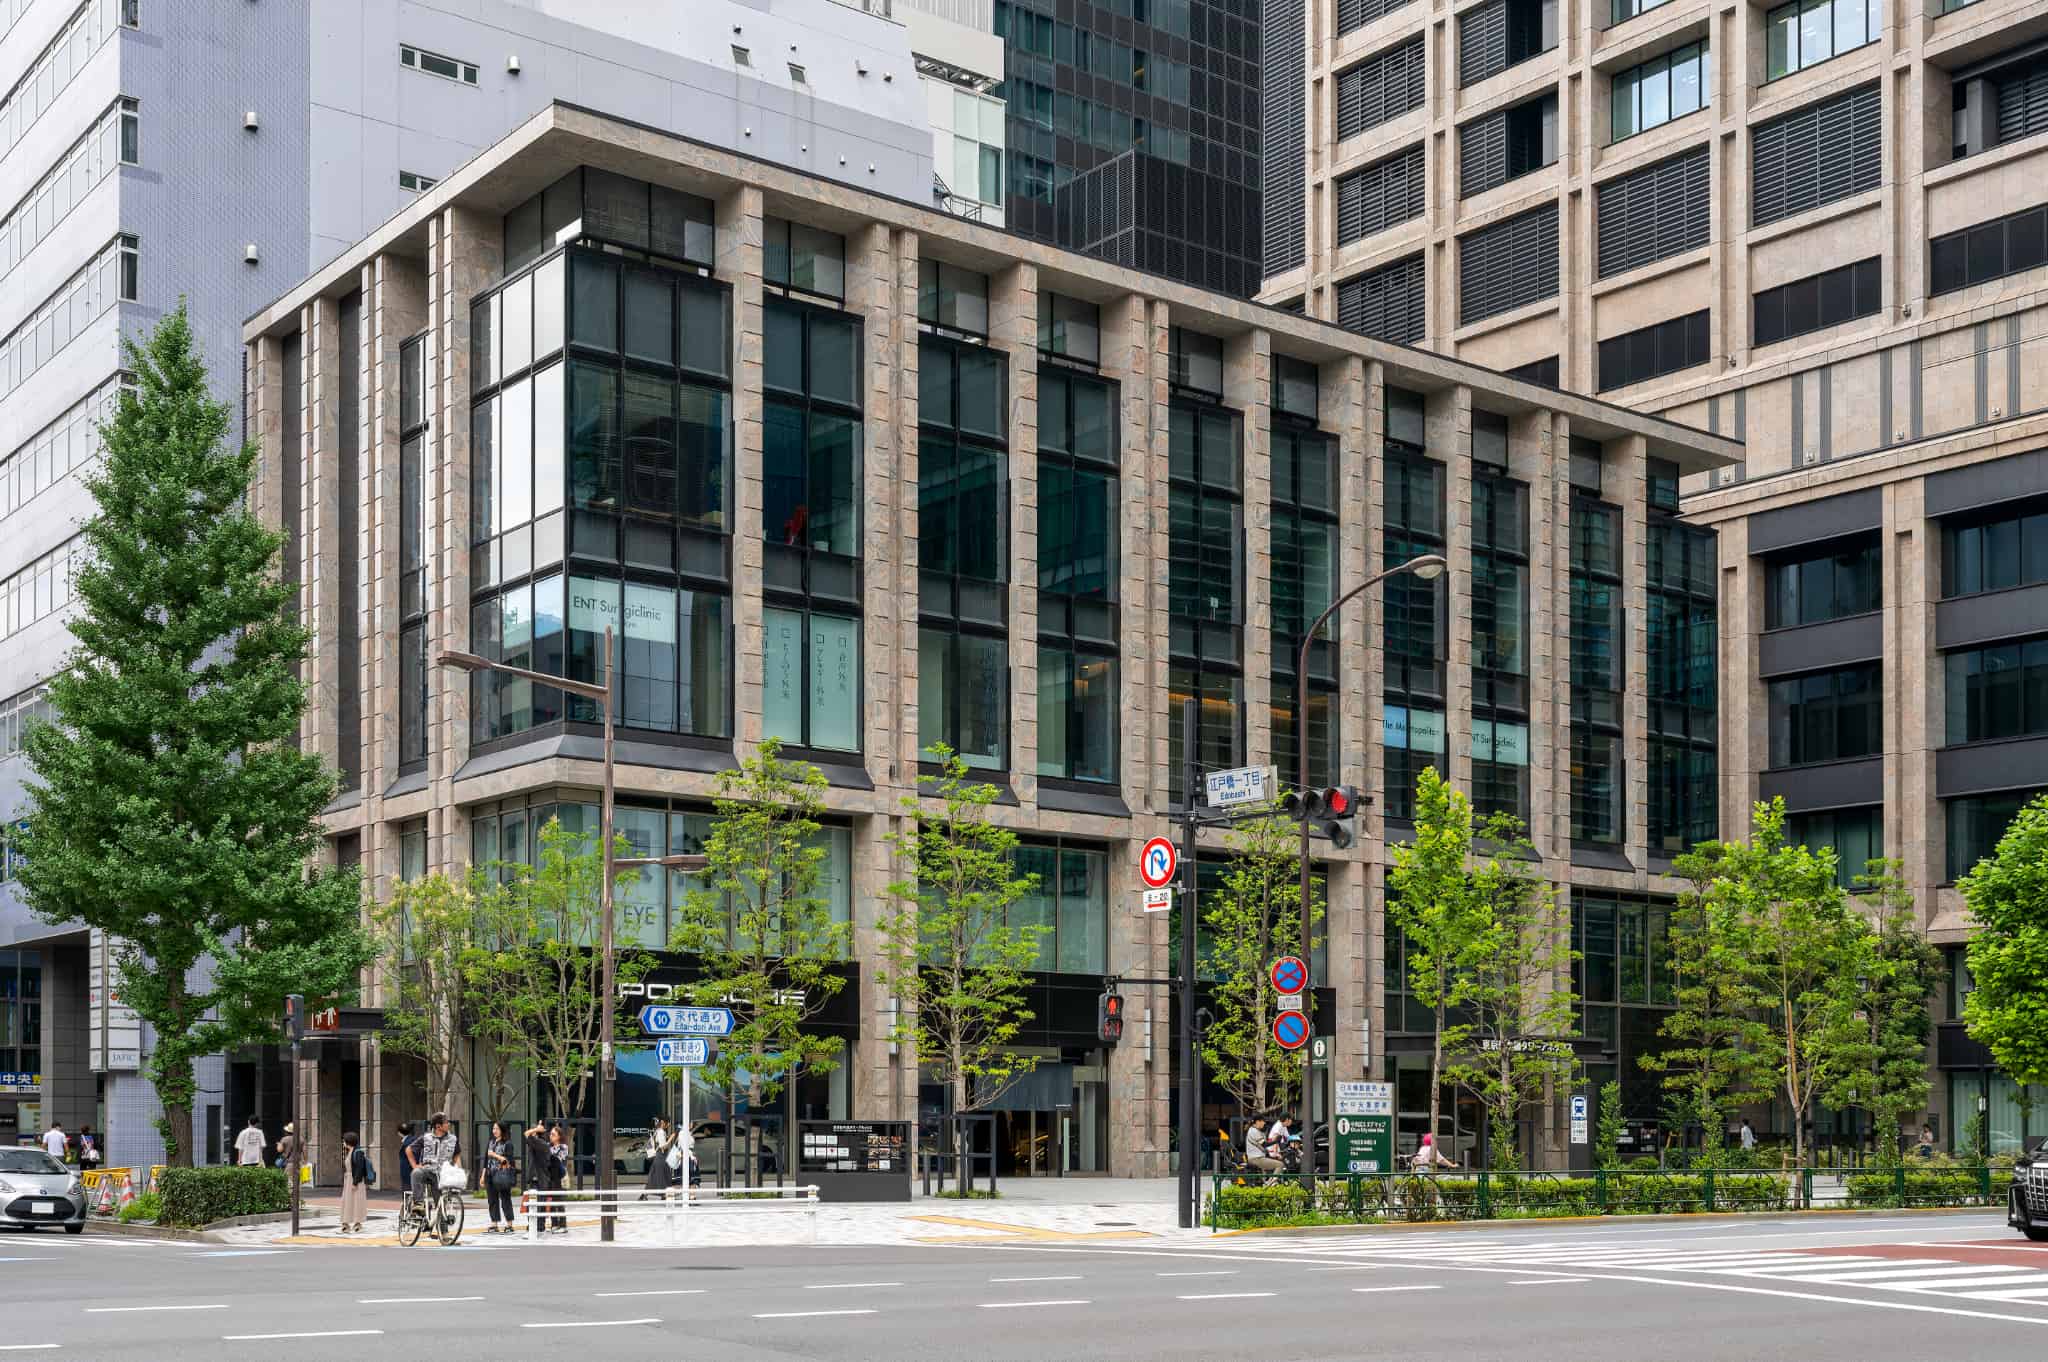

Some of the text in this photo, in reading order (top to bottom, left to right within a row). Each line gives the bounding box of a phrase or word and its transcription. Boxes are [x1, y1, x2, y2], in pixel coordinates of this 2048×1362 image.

[573, 595, 662, 620] ENT Surgiclinic
[1209, 770, 1261, 792] 江戸橋一丁目
[624, 905, 656, 925] EYE
[656, 1014, 669, 1026] 10
[674, 1011, 721, 1024] 永代通り
